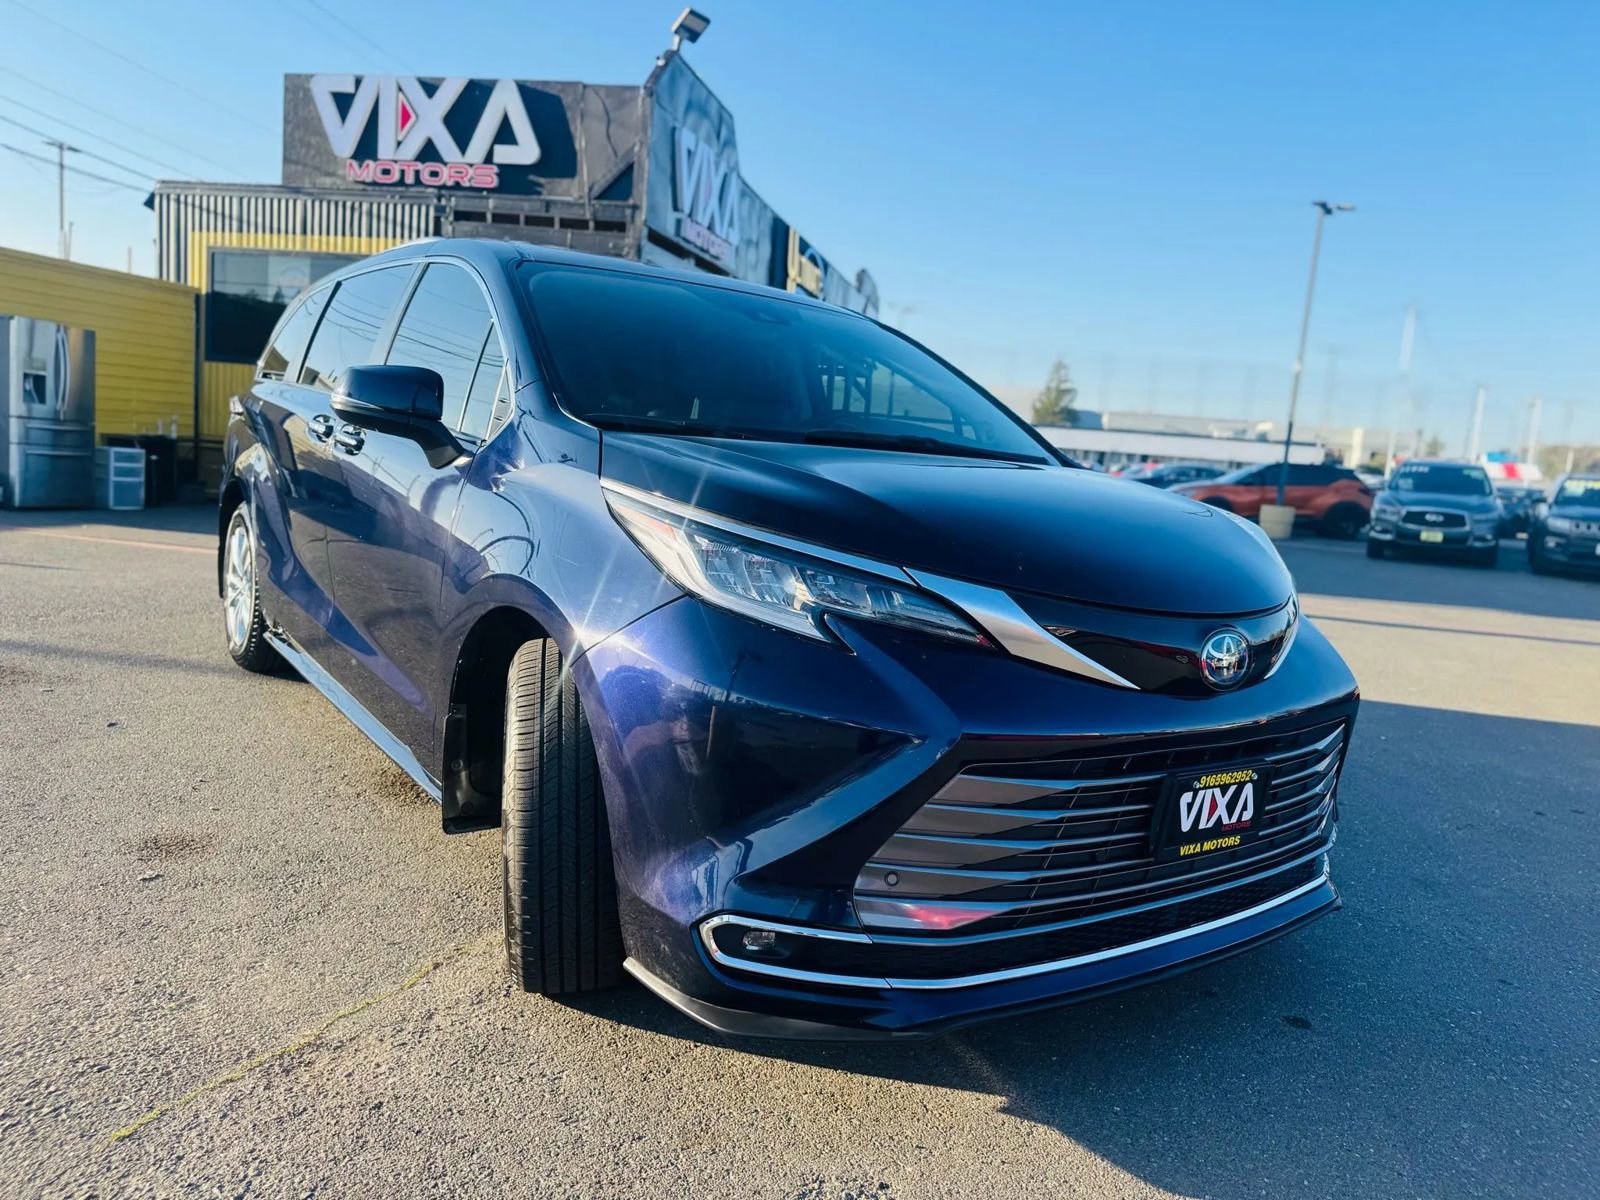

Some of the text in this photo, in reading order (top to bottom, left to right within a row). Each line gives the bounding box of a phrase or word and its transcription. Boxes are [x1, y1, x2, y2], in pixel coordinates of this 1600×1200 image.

[310, 74, 541, 165] VIXA
[345, 159, 500, 188] MOTORS
[676, 126, 738, 246] VIXA
[1199, 770, 1252, 787] 9165962952
[1180, 782, 1254, 833] VIXA
[1180, 835, 1241, 856] VIXA MOTORS
